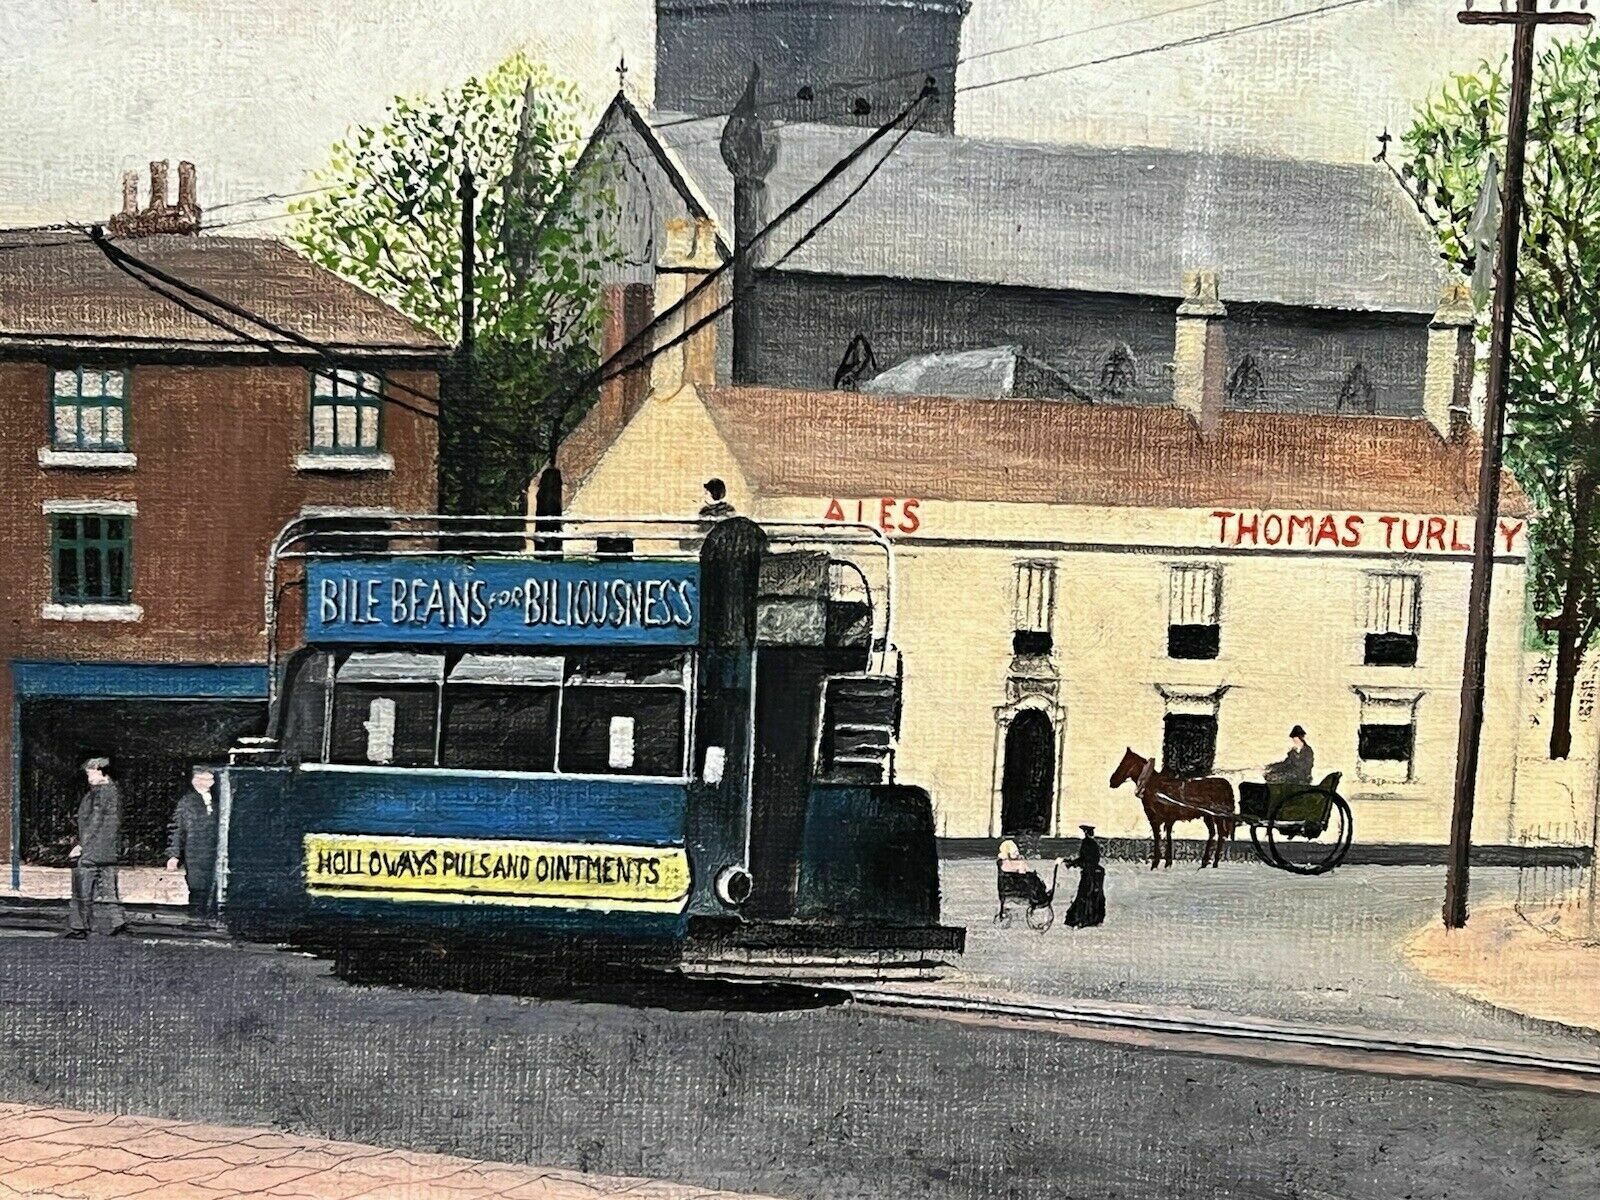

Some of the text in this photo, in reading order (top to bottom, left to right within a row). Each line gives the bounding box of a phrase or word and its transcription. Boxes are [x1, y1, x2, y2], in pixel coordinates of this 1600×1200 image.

[823, 497, 920, 534] ALES
[1211, 511, 1523, 552] THOMAS TURLY
[319, 578, 382, 624] BILE
[390, 578, 487, 627] BEANS
[523, 578, 693, 627] BILIOUSNESS
[536, 855, 660, 885] OINTMENTS
